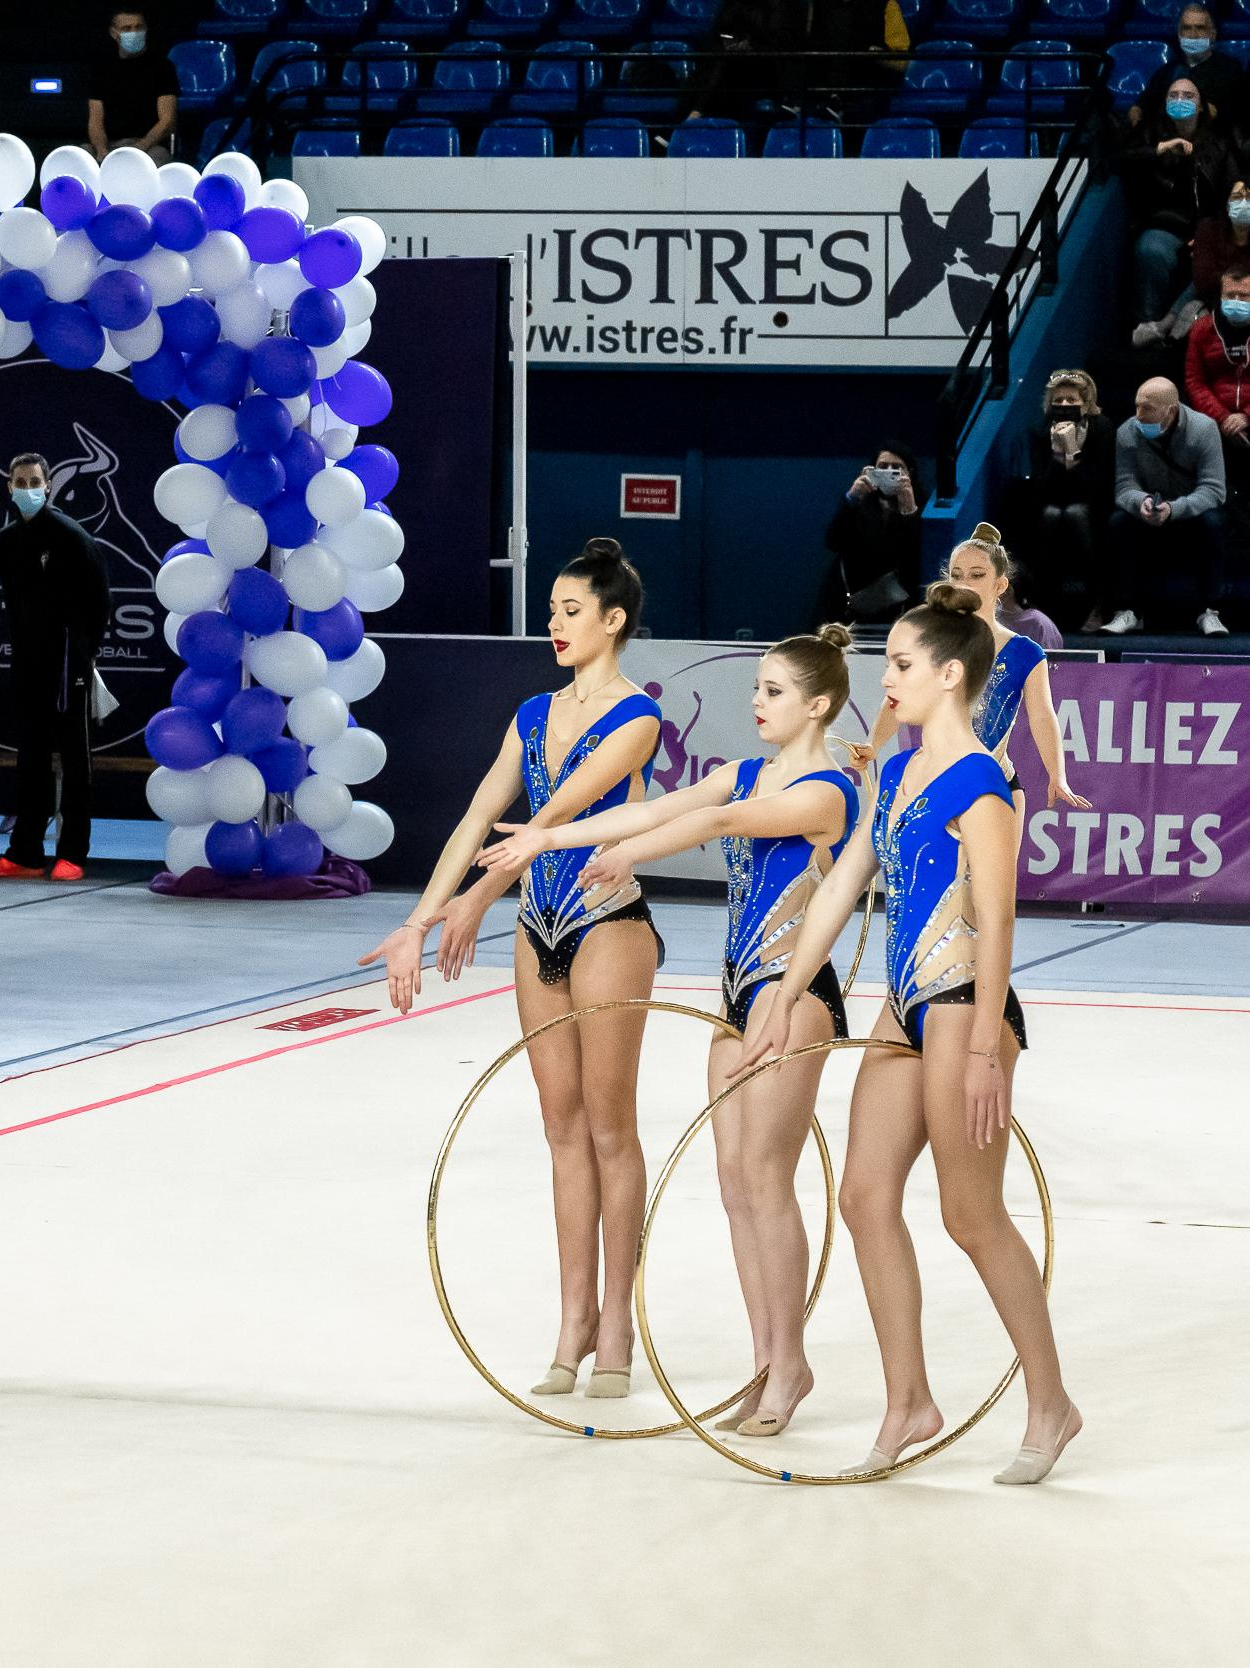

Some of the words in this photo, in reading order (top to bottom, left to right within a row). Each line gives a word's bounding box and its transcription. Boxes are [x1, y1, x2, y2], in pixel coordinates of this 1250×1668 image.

[526, 314, 754, 354] w.istres.fr
[634, 487, 667, 495] INTERDIT
[1056, 699, 1242, 765] ALLEZ
[1028, 810, 1223, 878] STRES
